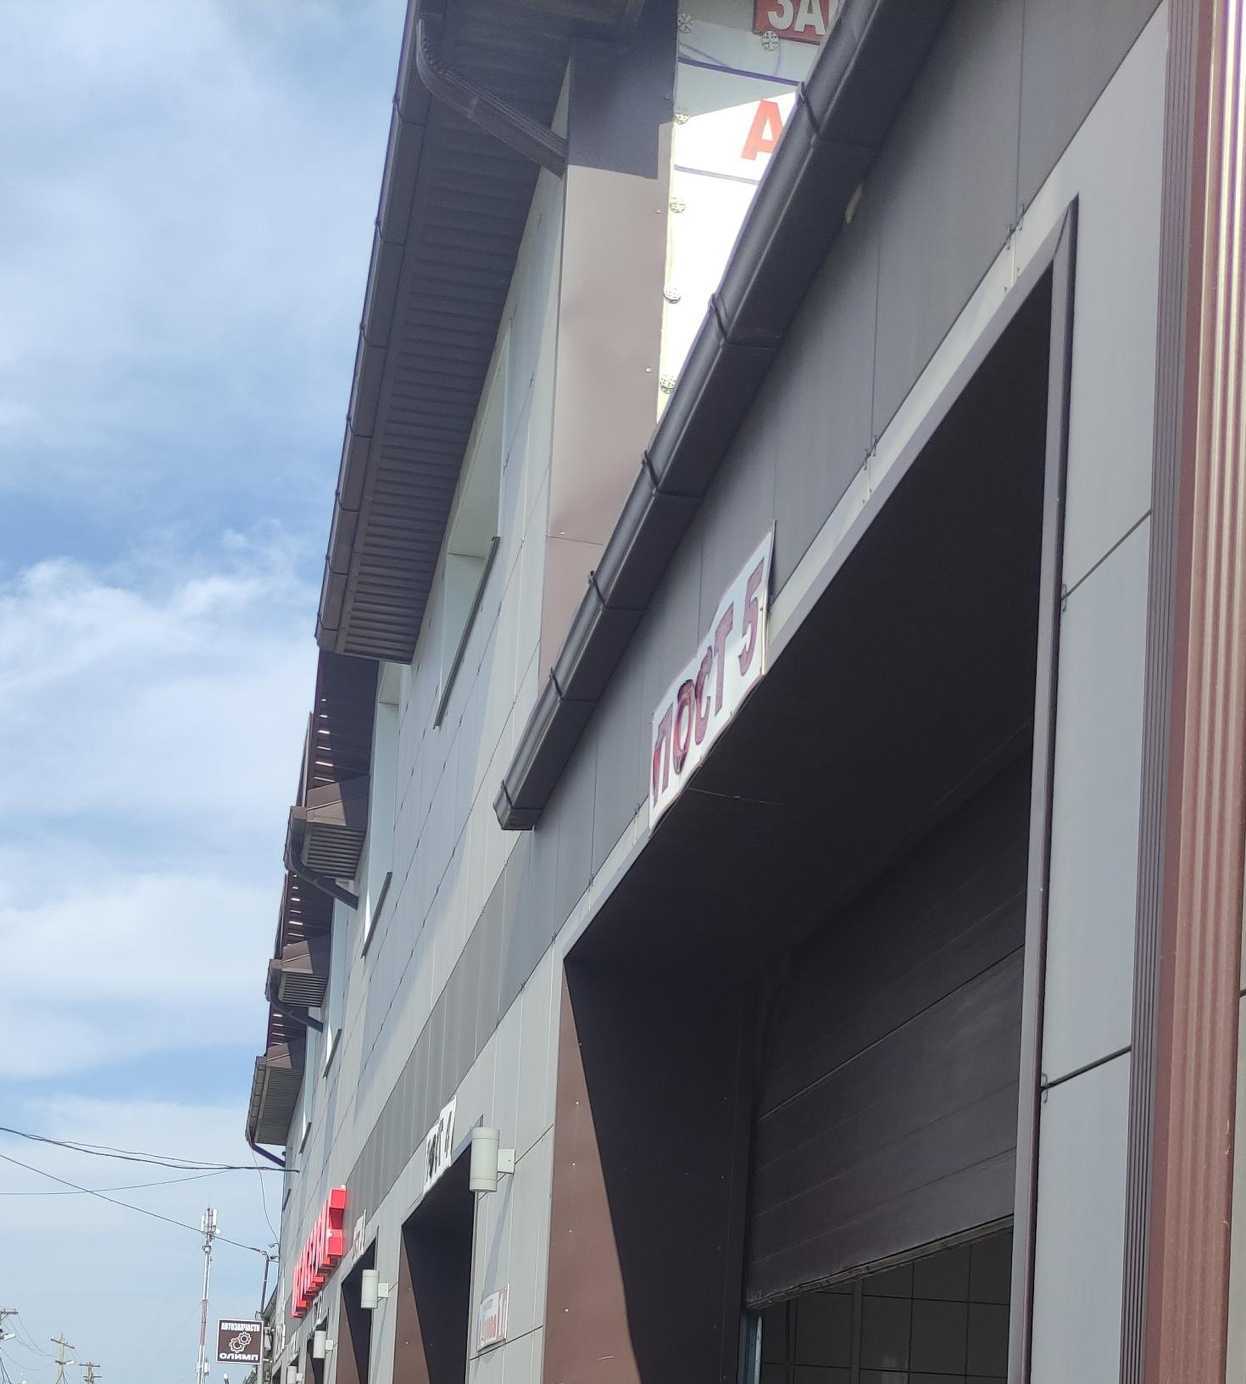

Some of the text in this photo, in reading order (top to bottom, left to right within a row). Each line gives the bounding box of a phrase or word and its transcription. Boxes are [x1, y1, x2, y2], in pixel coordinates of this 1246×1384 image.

[652, 557, 765, 808] ПОСТ 5
[220, 1353, 258, 1361] ОЛИМП
